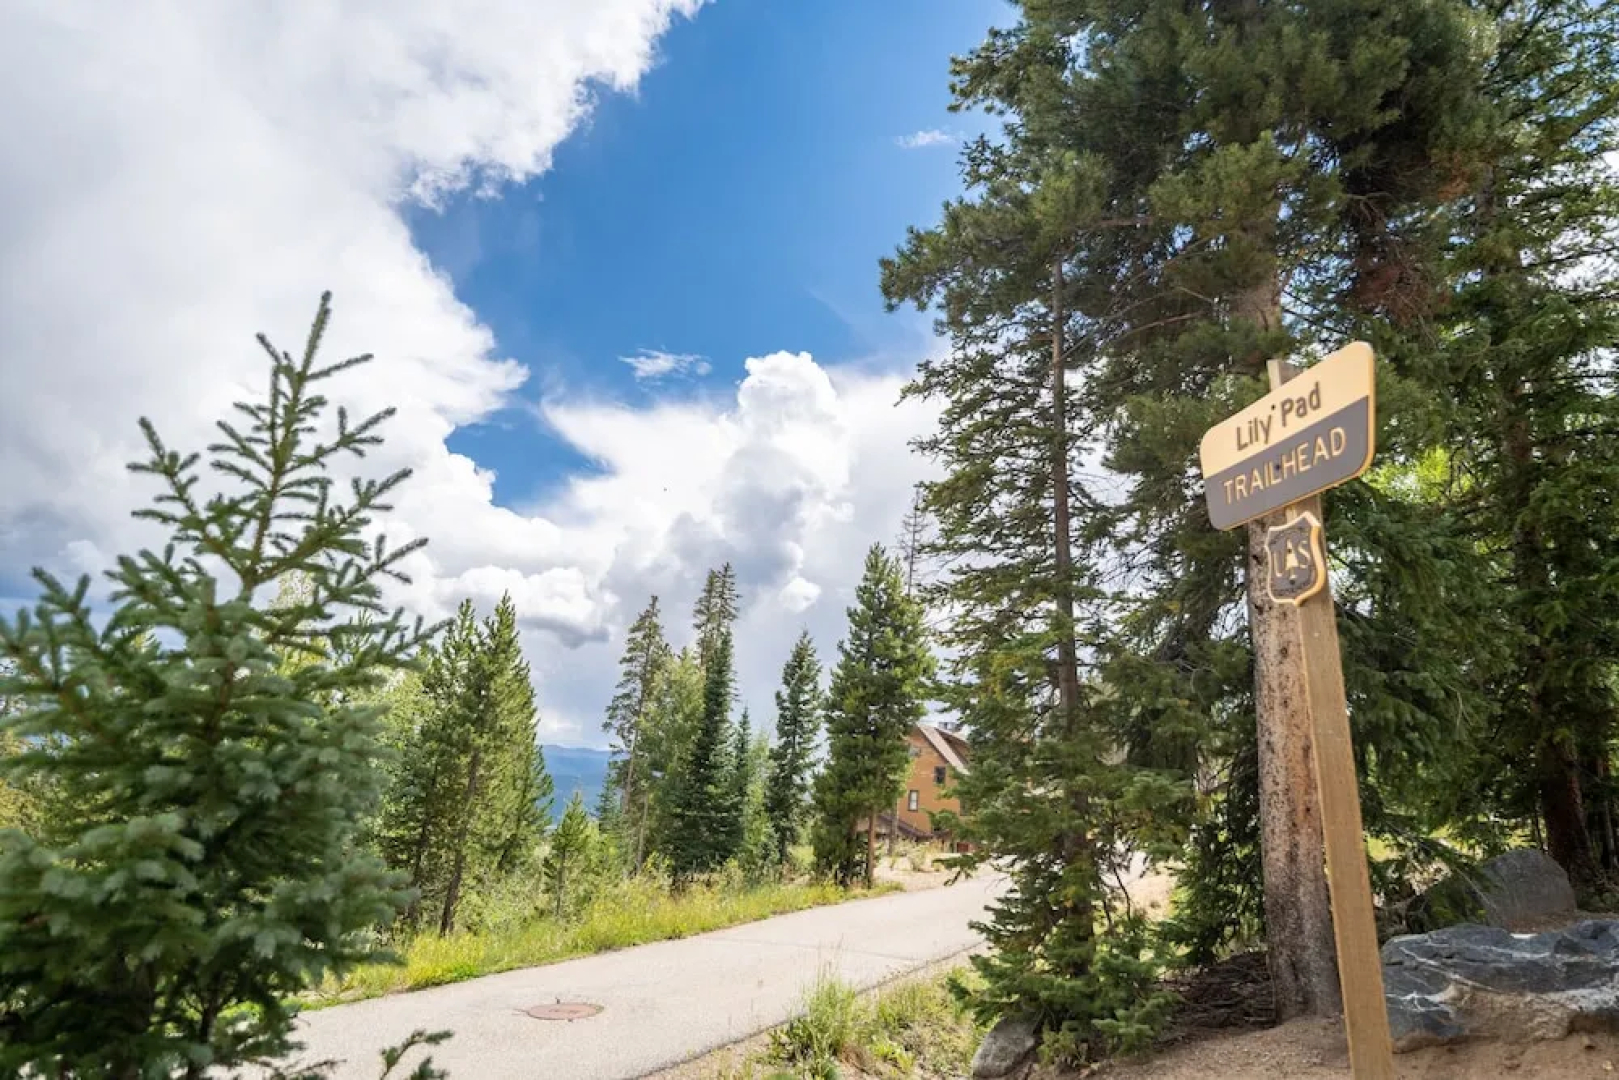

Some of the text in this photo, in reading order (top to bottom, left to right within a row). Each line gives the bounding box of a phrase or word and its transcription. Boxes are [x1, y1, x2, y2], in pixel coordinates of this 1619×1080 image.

[1236, 381, 1321, 451] Lily Pad
[1224, 427, 1346, 504] TRAILHEAD
